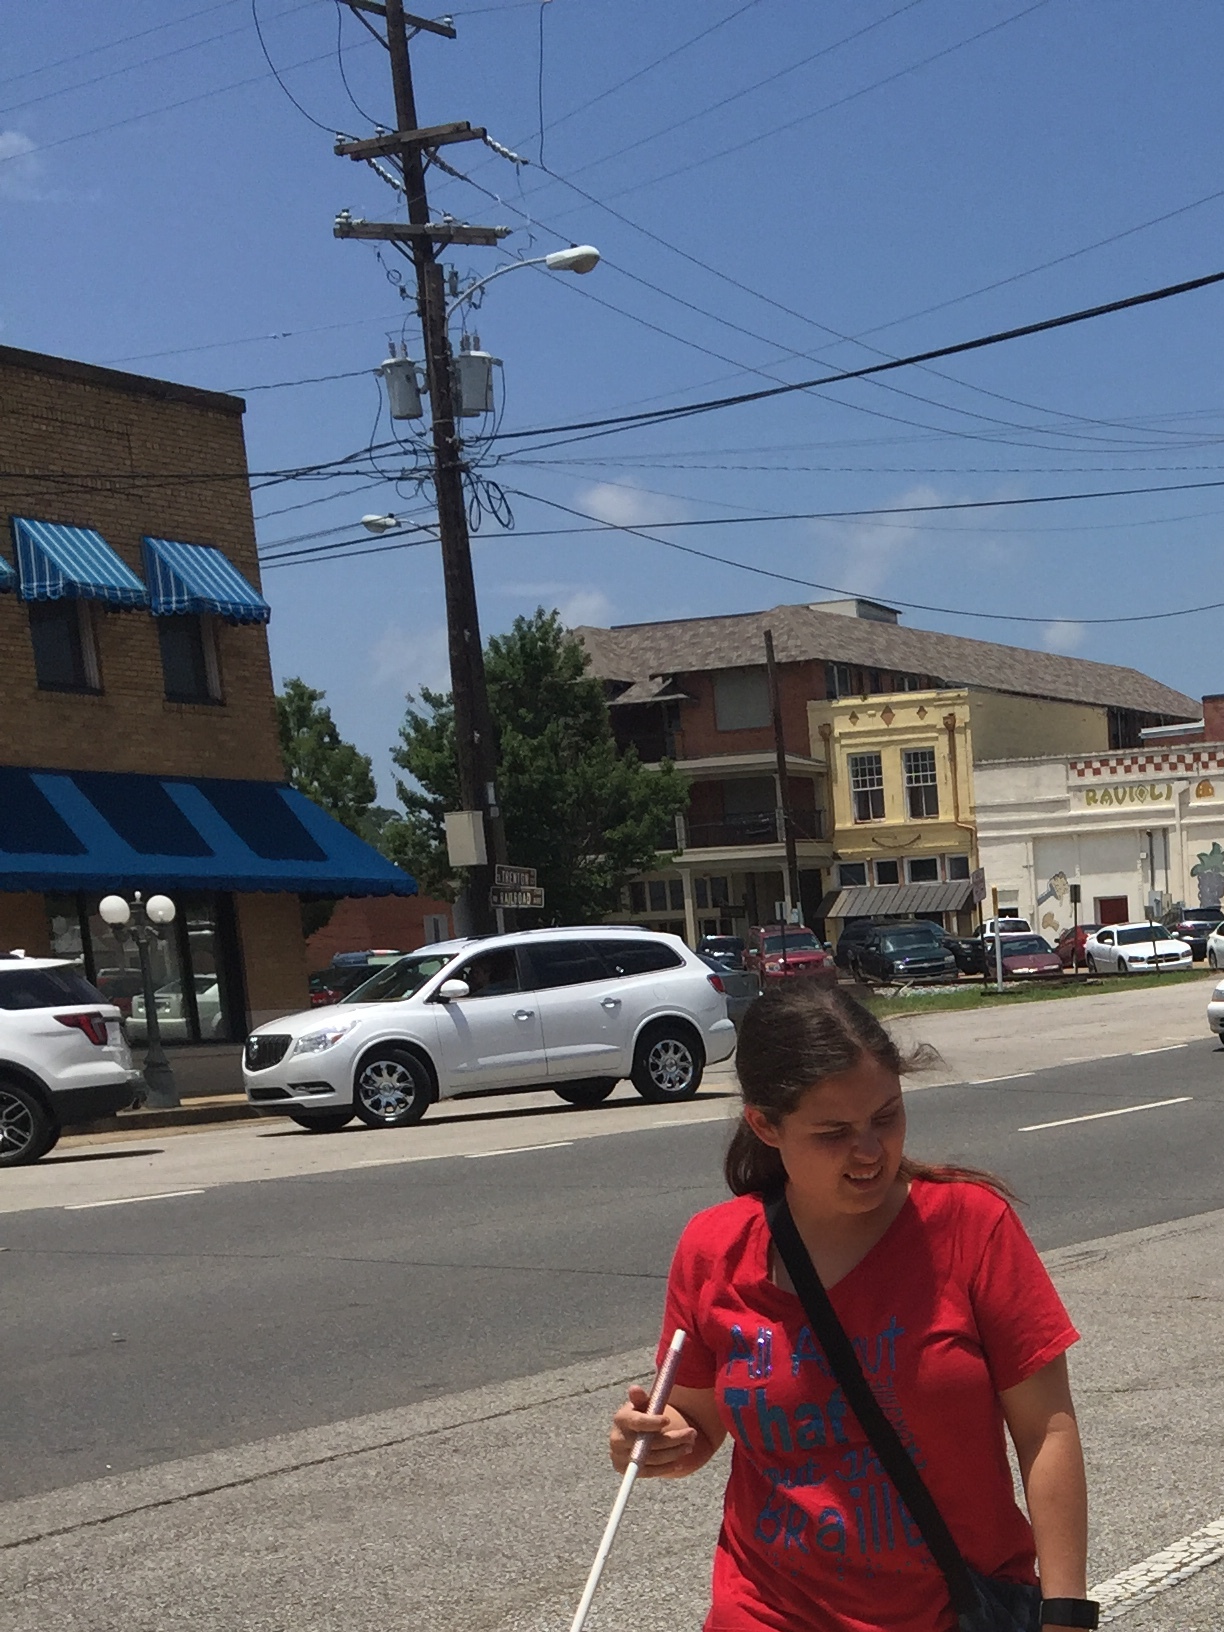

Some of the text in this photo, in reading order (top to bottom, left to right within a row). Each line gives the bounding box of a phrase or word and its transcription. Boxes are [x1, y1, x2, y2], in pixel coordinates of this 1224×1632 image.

[1085, 783, 1173, 807] RAVIOLI
[724, 1315, 905, 1379] All Aut
[723, 1385, 850, 1453] That
[834, 1447, 889, 1482] Th
